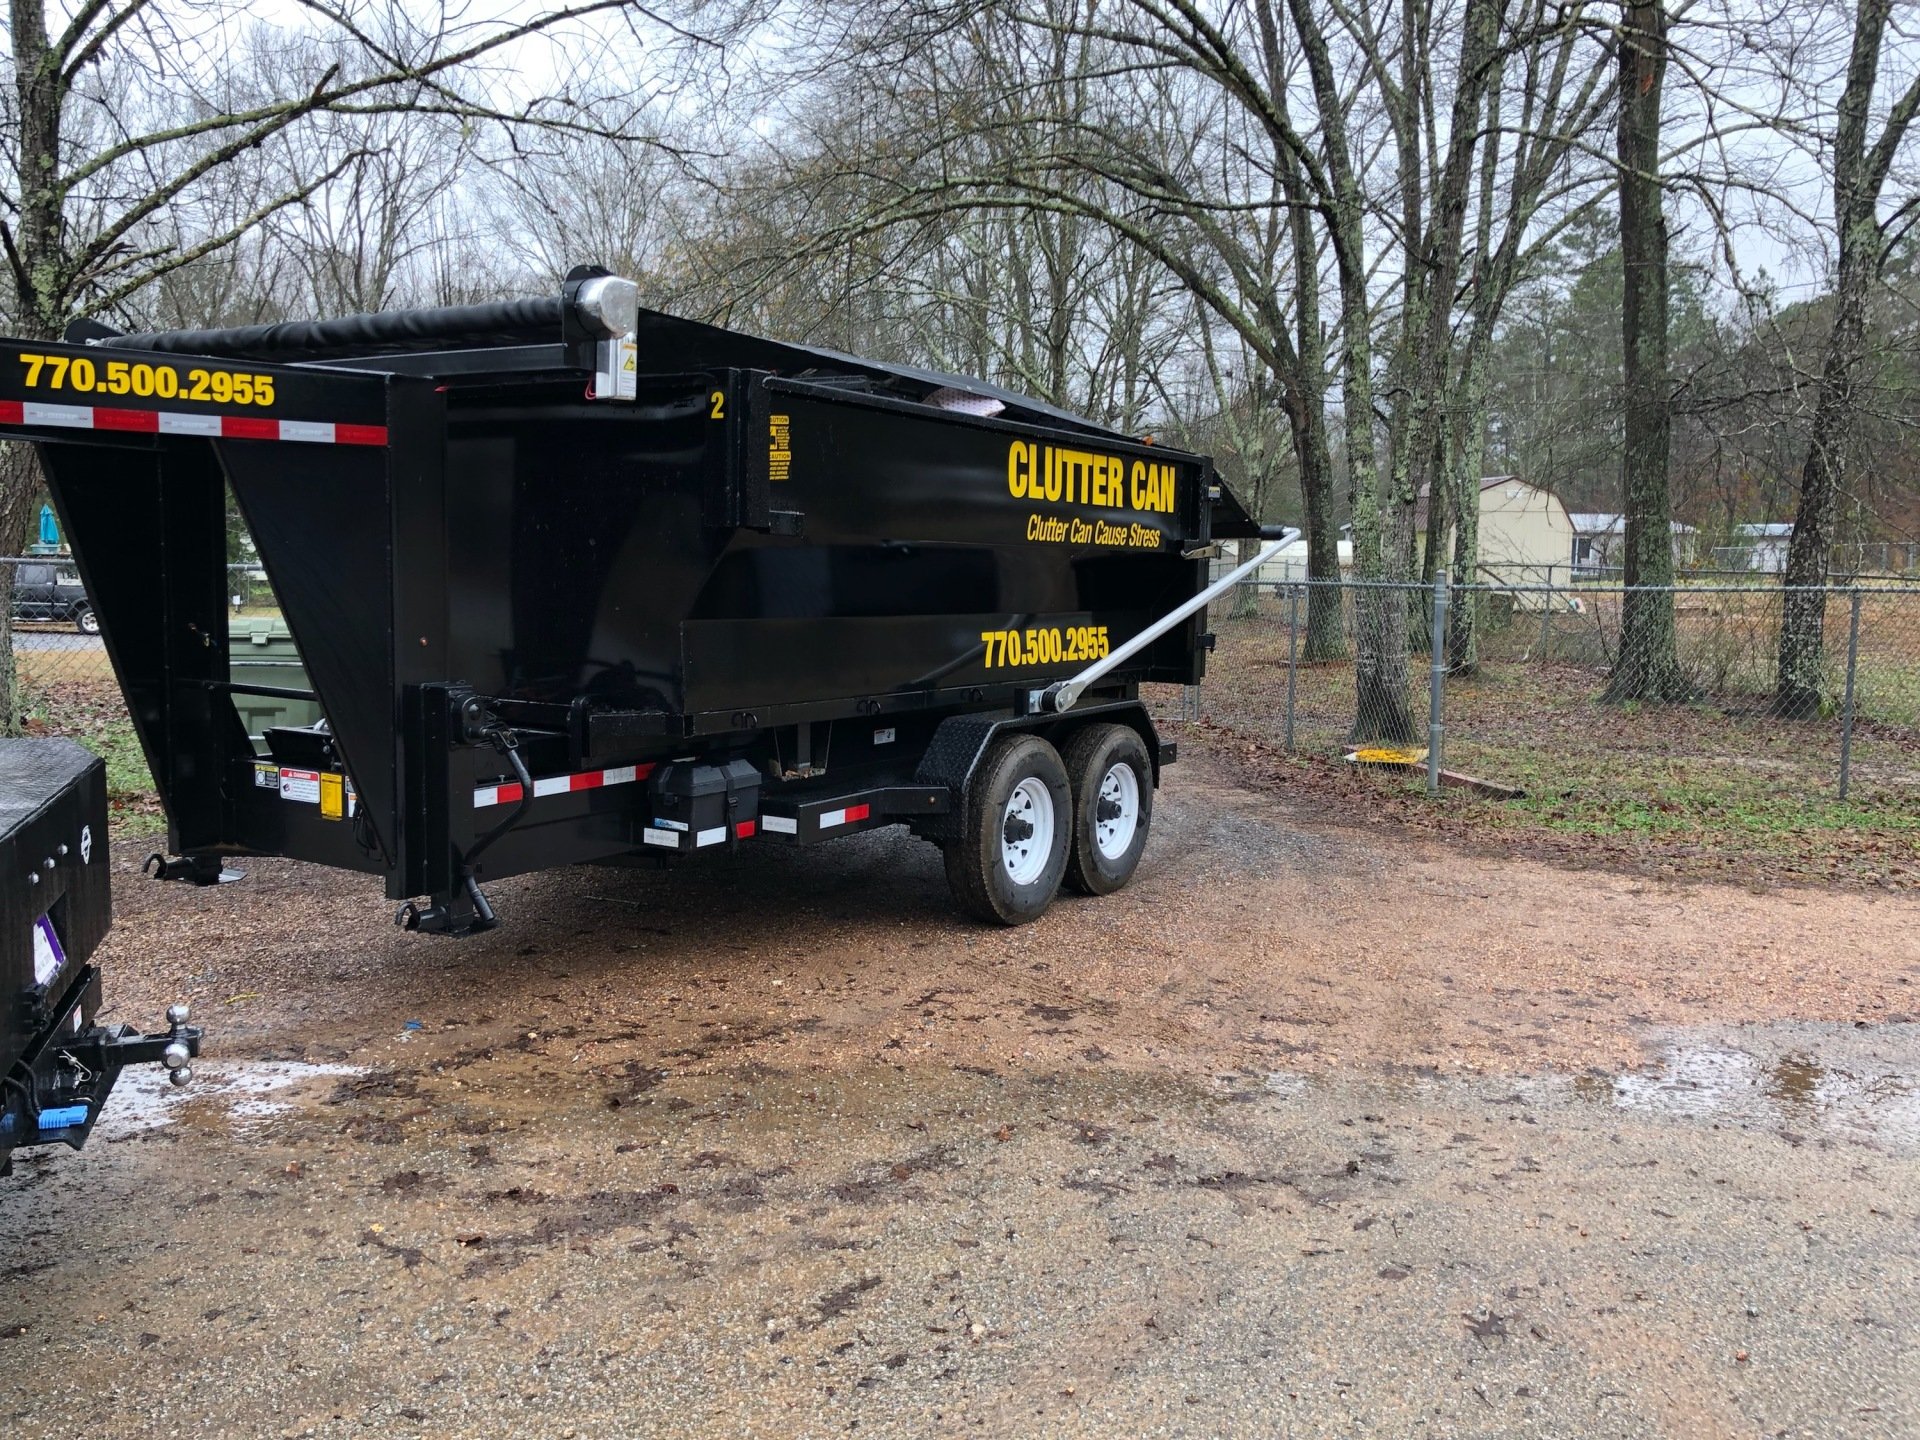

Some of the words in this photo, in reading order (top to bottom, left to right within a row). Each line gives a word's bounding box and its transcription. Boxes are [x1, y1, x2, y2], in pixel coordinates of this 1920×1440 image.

[19, 354, 275, 406] 770.500.2955
[711, 391, 724, 419] 2
[1008, 440, 1124, 508] CLUTTER
[1131, 460, 1176, 513] CAN
[1027, 514, 1069, 542] Clutter
[1070, 517, 1093, 544] Can
[1094, 520, 1127, 546] Cause
[1129, 522, 1161, 548] Stress
[981, 626, 1110, 669] 770.500.2955
